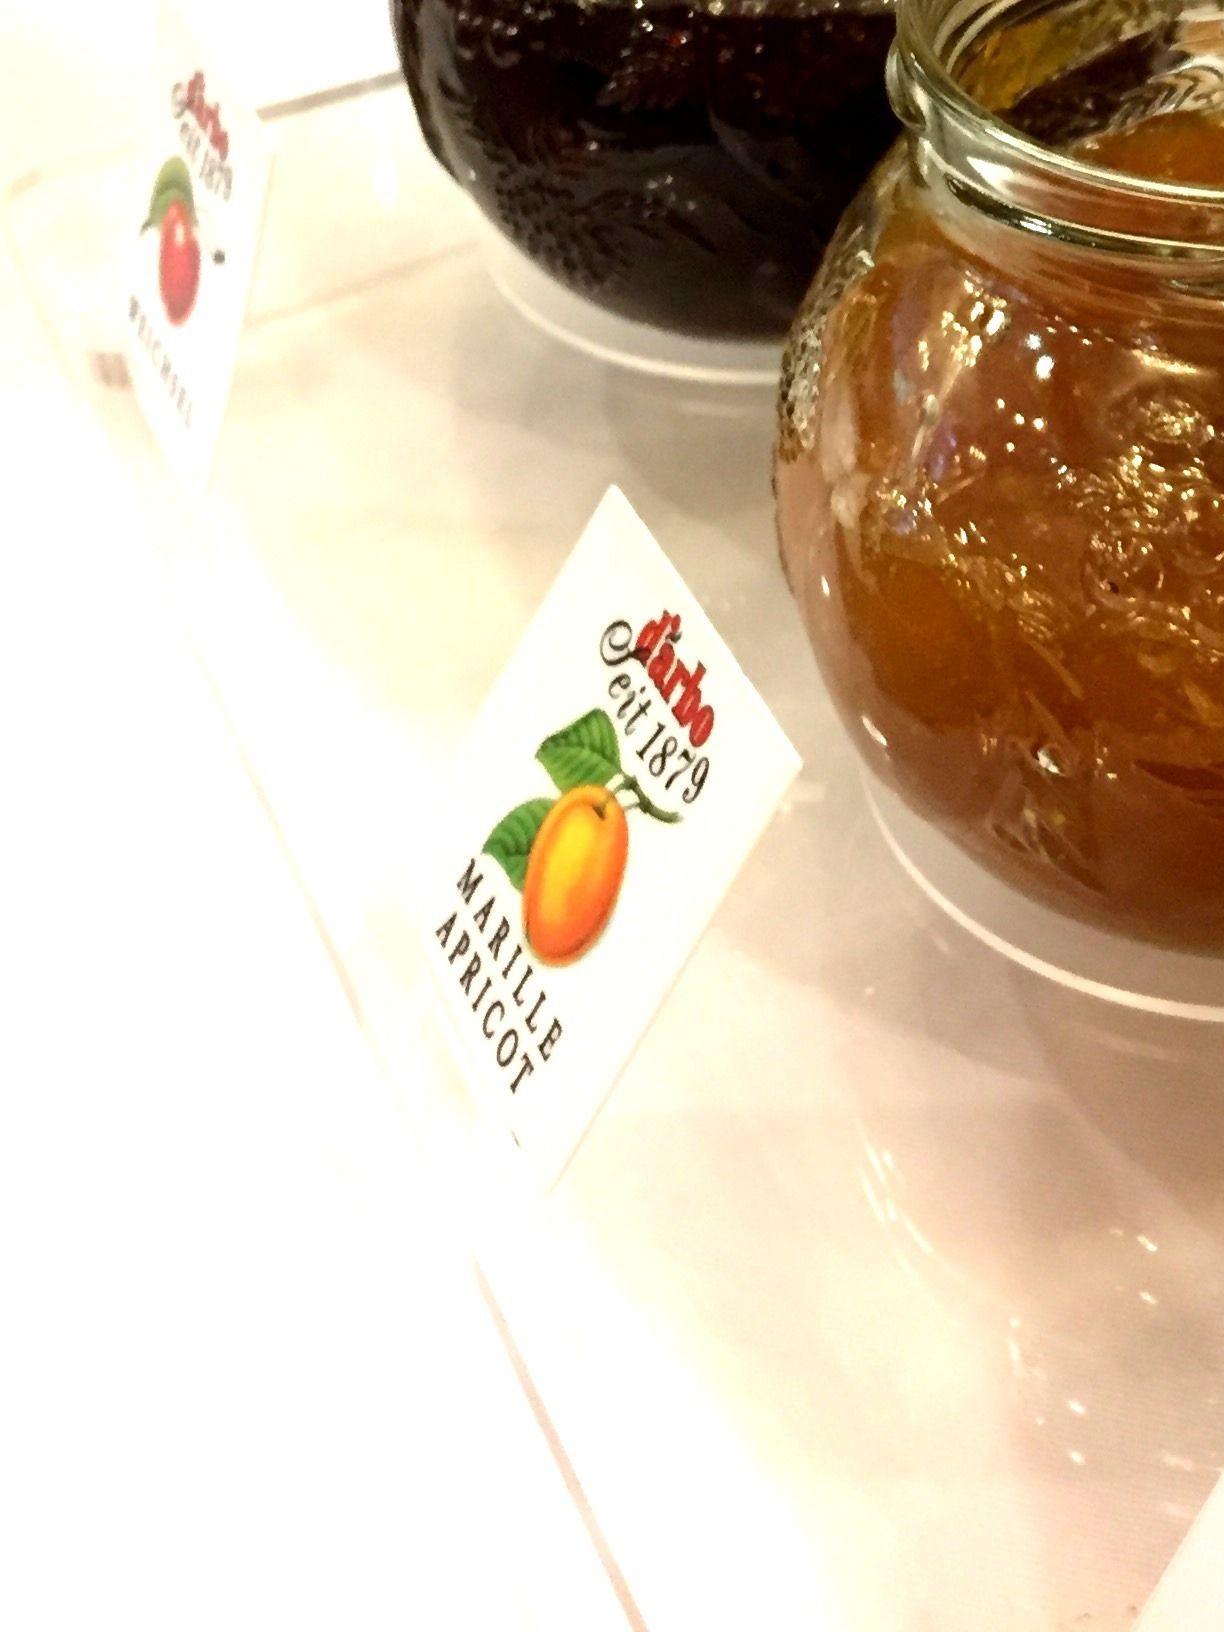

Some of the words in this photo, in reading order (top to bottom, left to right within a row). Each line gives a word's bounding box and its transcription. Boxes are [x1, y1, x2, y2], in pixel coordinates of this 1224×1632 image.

[635, 721, 711, 805] 1879
[435, 911, 555, 1095] APRICOT
[456, 857, 563, 1062] MARILLE
